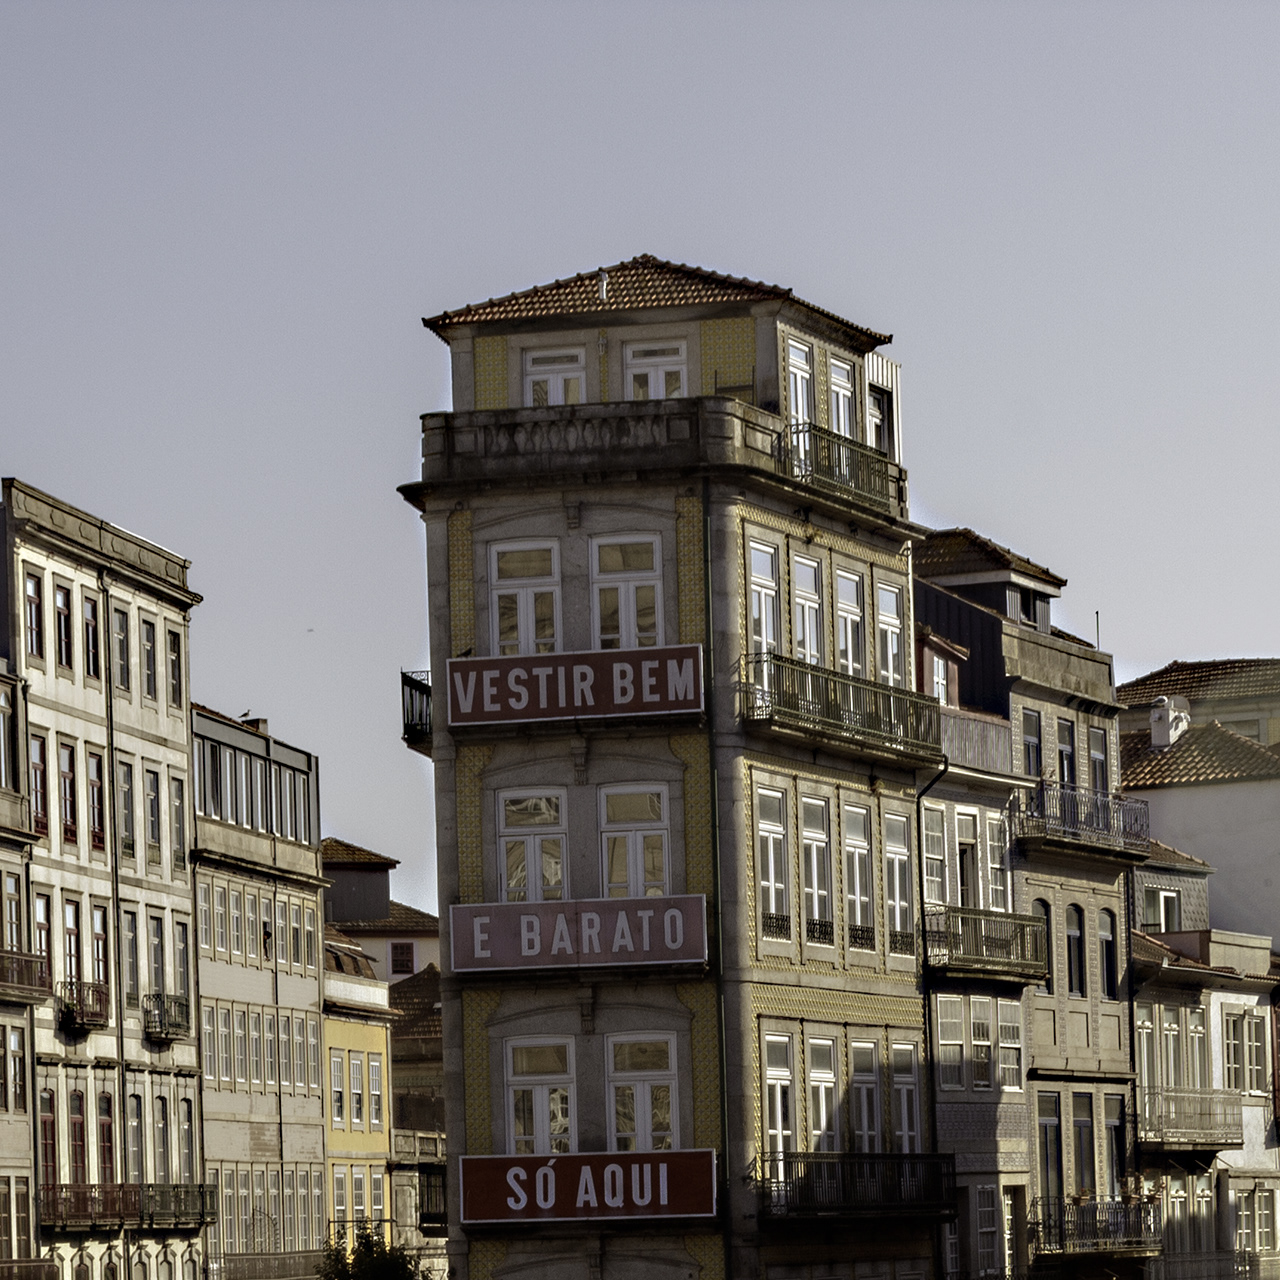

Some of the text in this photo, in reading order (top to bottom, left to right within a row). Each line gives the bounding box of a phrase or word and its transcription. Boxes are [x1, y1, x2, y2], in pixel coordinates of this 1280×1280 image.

[453, 658, 695, 714] VESTIR BEM
[473, 908, 684, 959] E BARATO
[506, 1158, 669, 1211] SÓ AQUI
